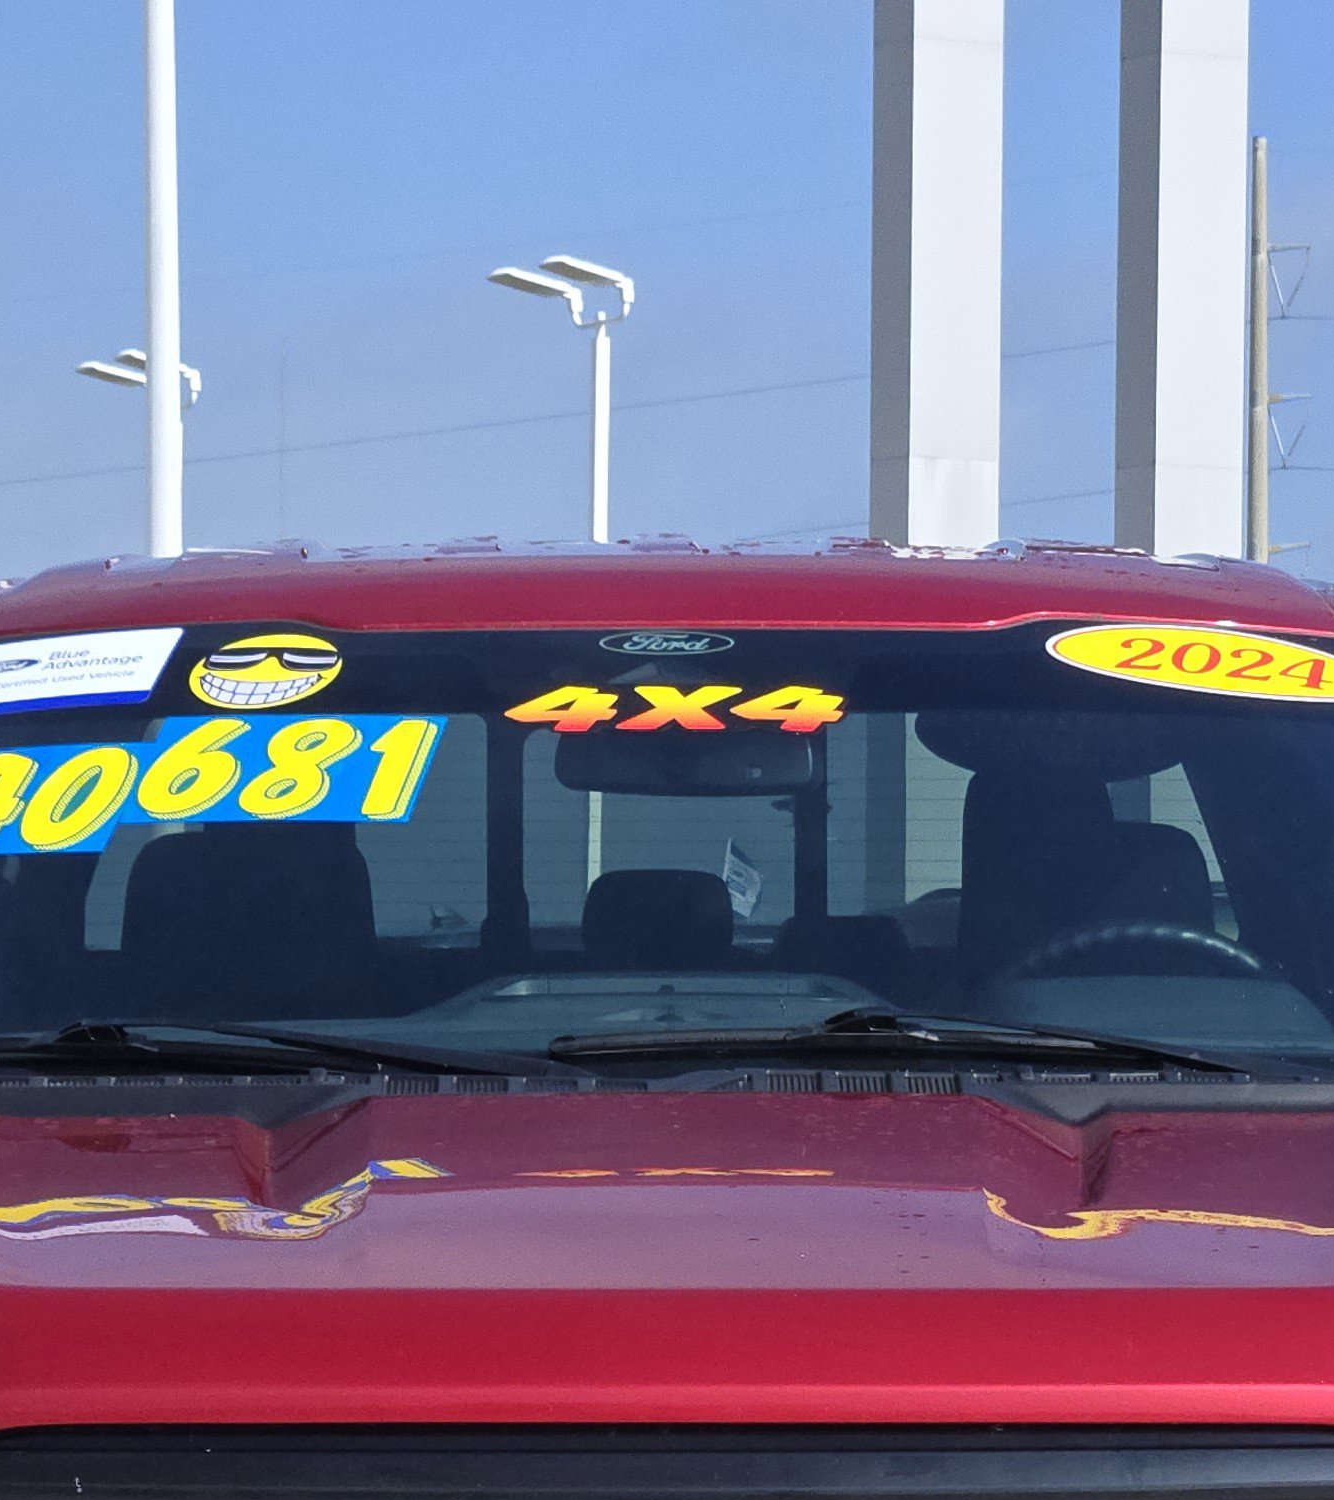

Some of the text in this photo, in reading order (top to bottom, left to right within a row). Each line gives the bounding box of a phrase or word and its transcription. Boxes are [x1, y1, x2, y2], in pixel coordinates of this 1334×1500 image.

[622, 633, 711, 650] Ford
[41, 654, 144, 671] Advantage
[48, 650, 91, 661] Blue
[1113, 637, 1333, 690] 2024
